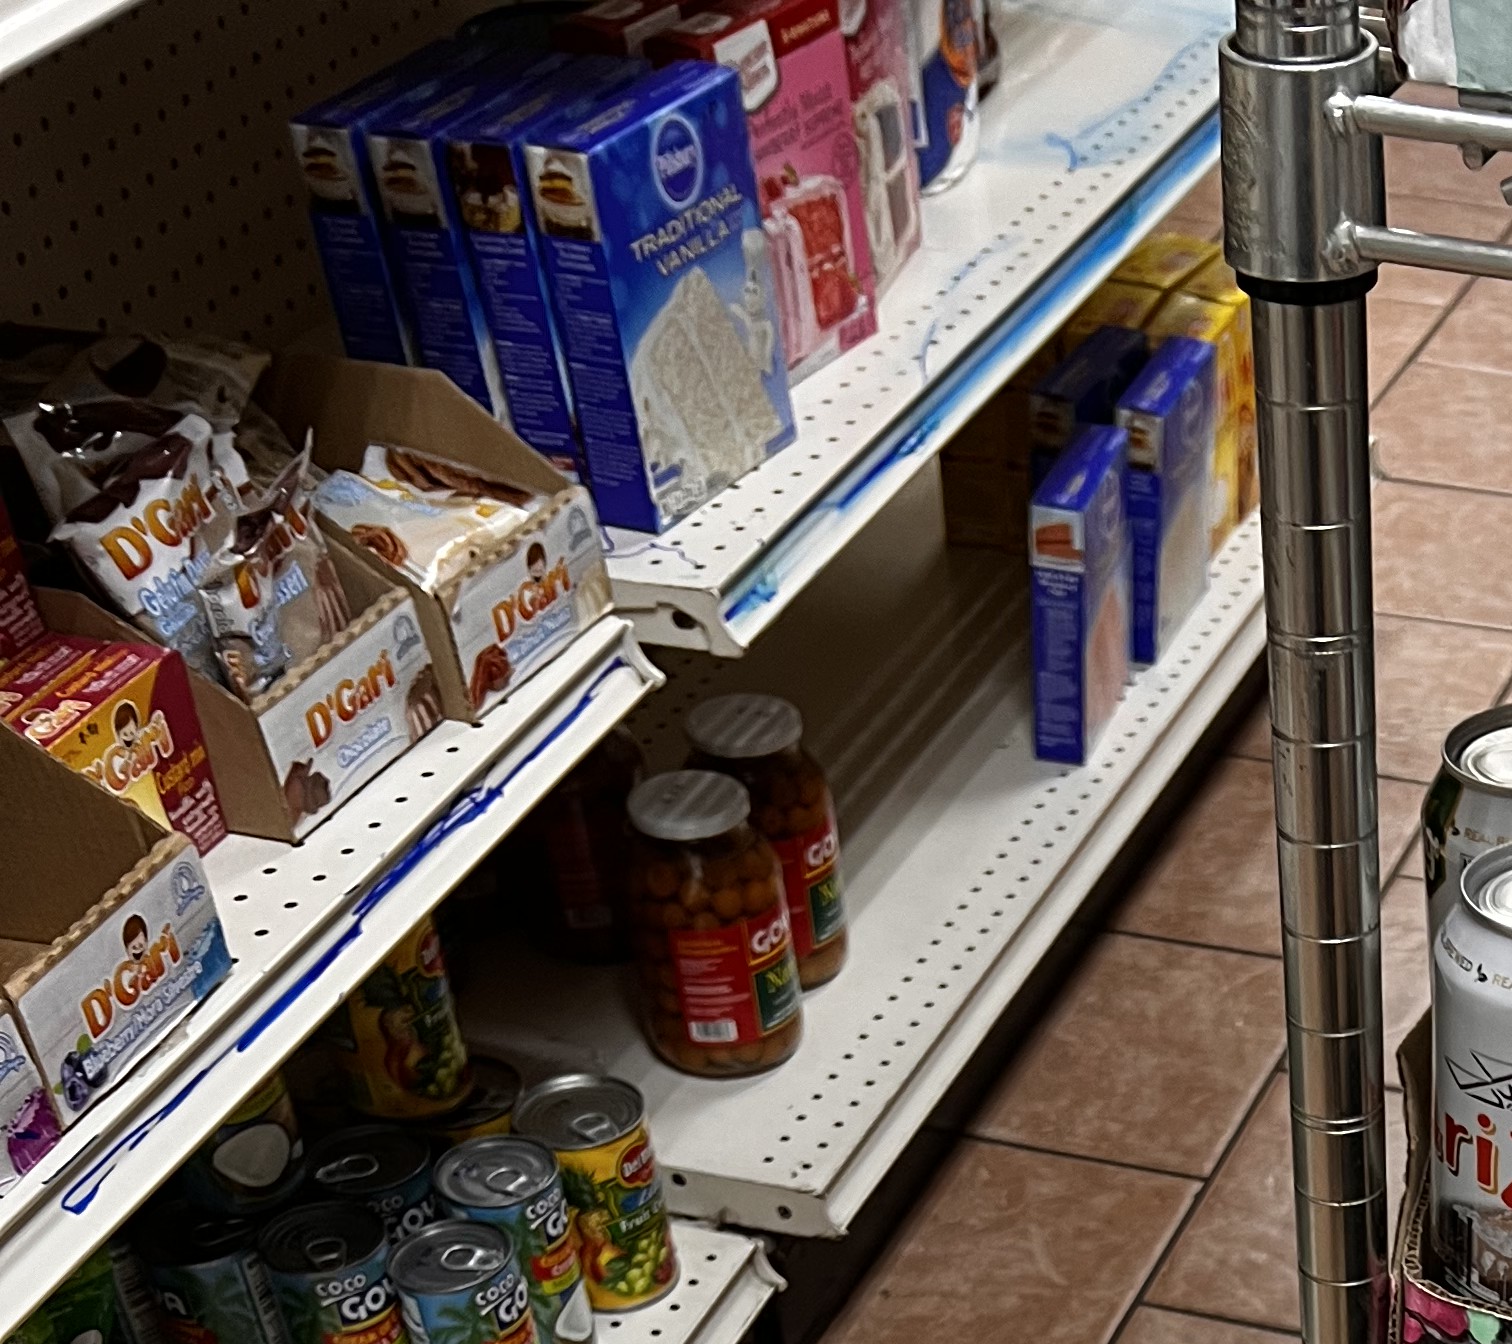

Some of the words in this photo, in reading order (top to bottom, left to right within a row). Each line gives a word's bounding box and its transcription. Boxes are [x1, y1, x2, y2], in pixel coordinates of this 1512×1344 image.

[630, 184, 743, 262] TRADITIONAL
[304, 649, 397, 748] D'Gari
[81, 709, 175, 795] 'Gari
[79, 921, 184, 1041] D'Gari
[315, 1273, 367, 1298] COCO
